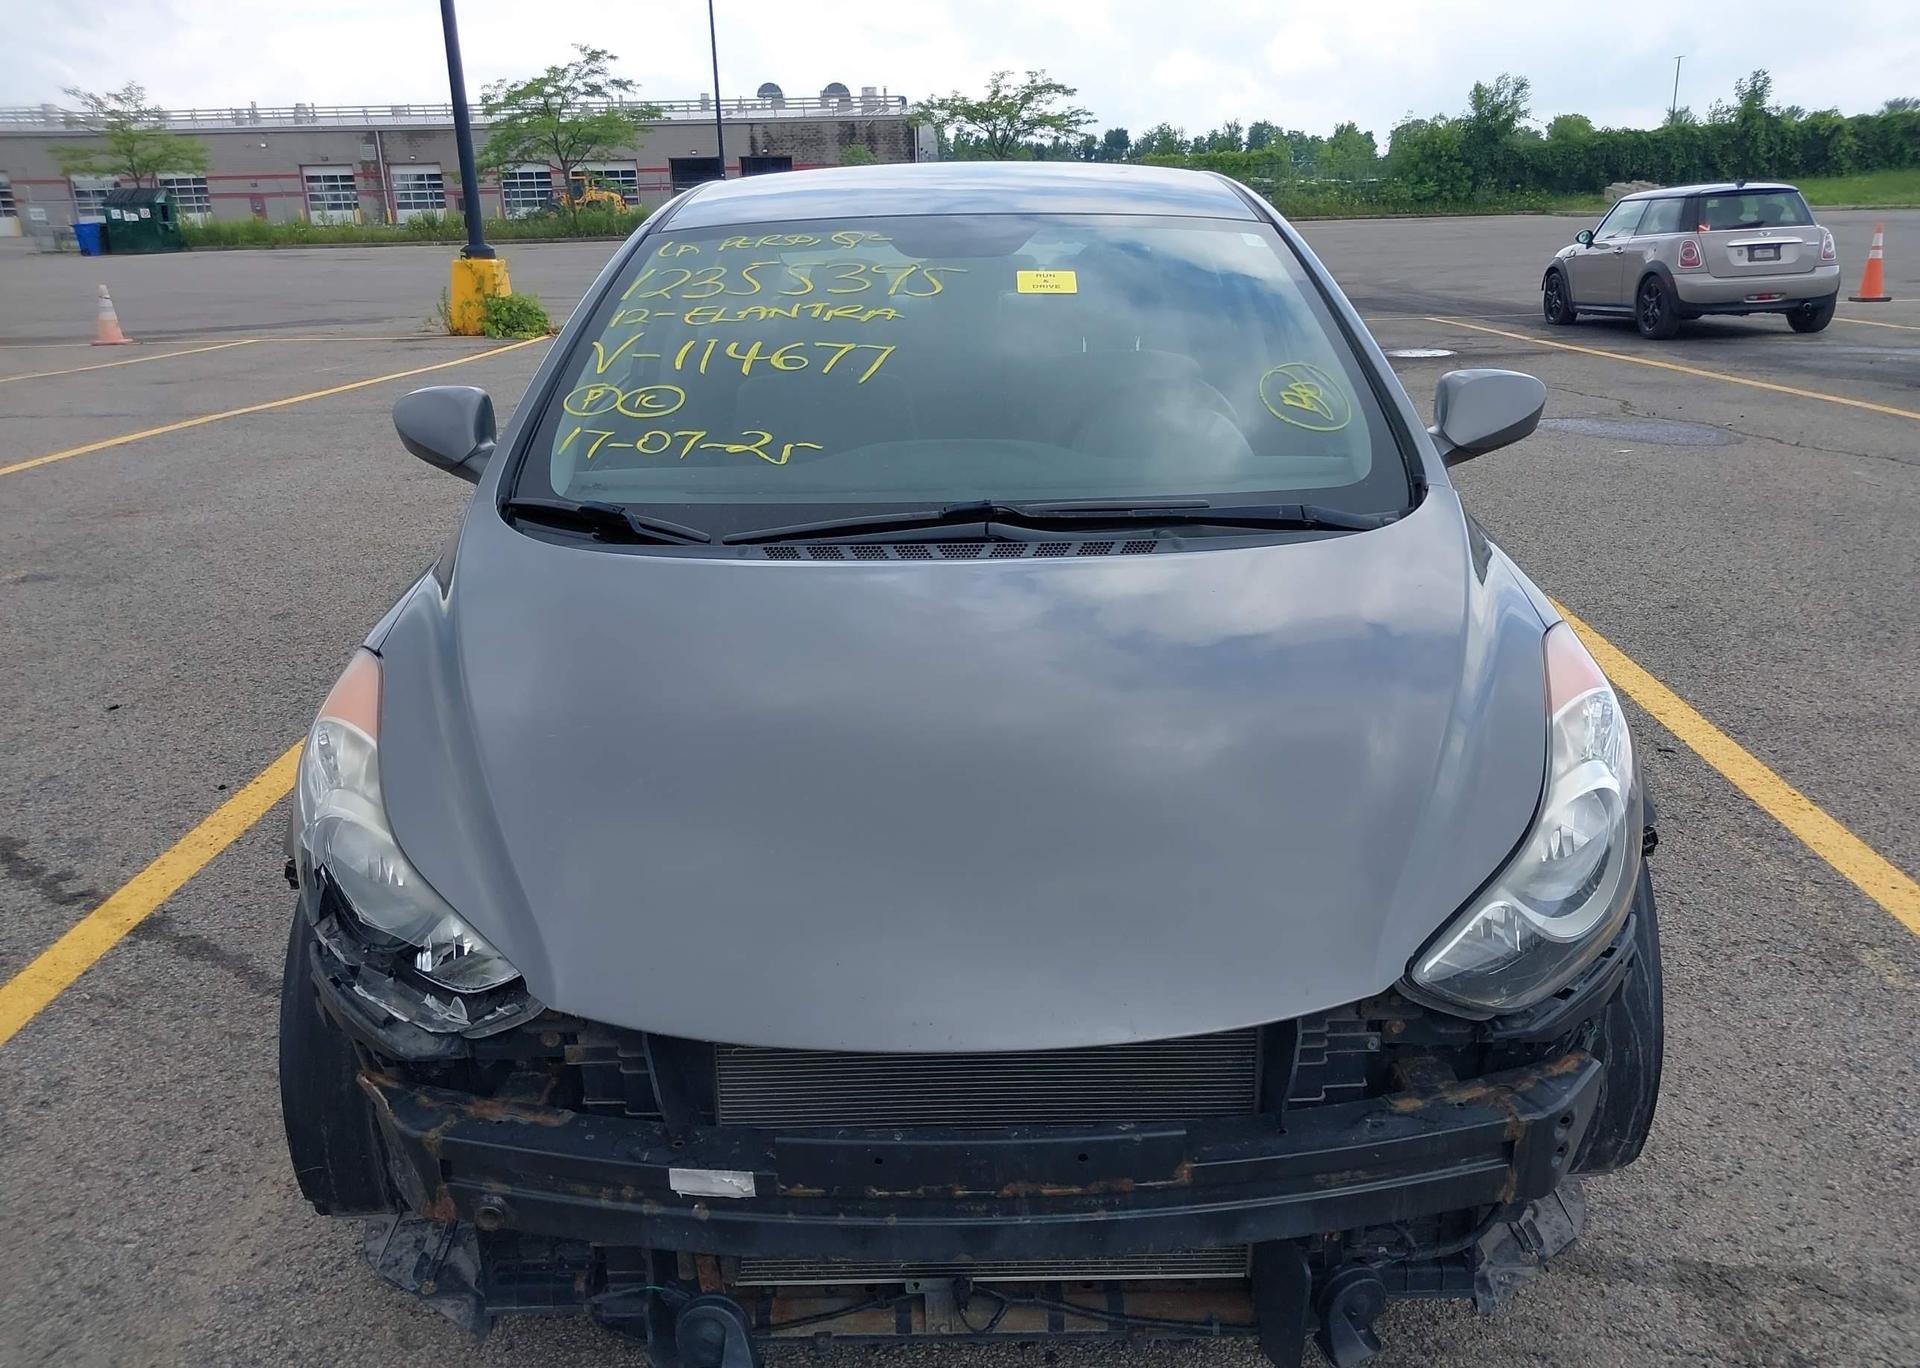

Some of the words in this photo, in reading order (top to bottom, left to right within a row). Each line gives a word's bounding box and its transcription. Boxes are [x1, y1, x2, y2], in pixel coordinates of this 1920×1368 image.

[658, 241, 700, 257] LA
[620, 261, 969, 300] 12355395
[557, 426, 824, 465] 17-07-25
